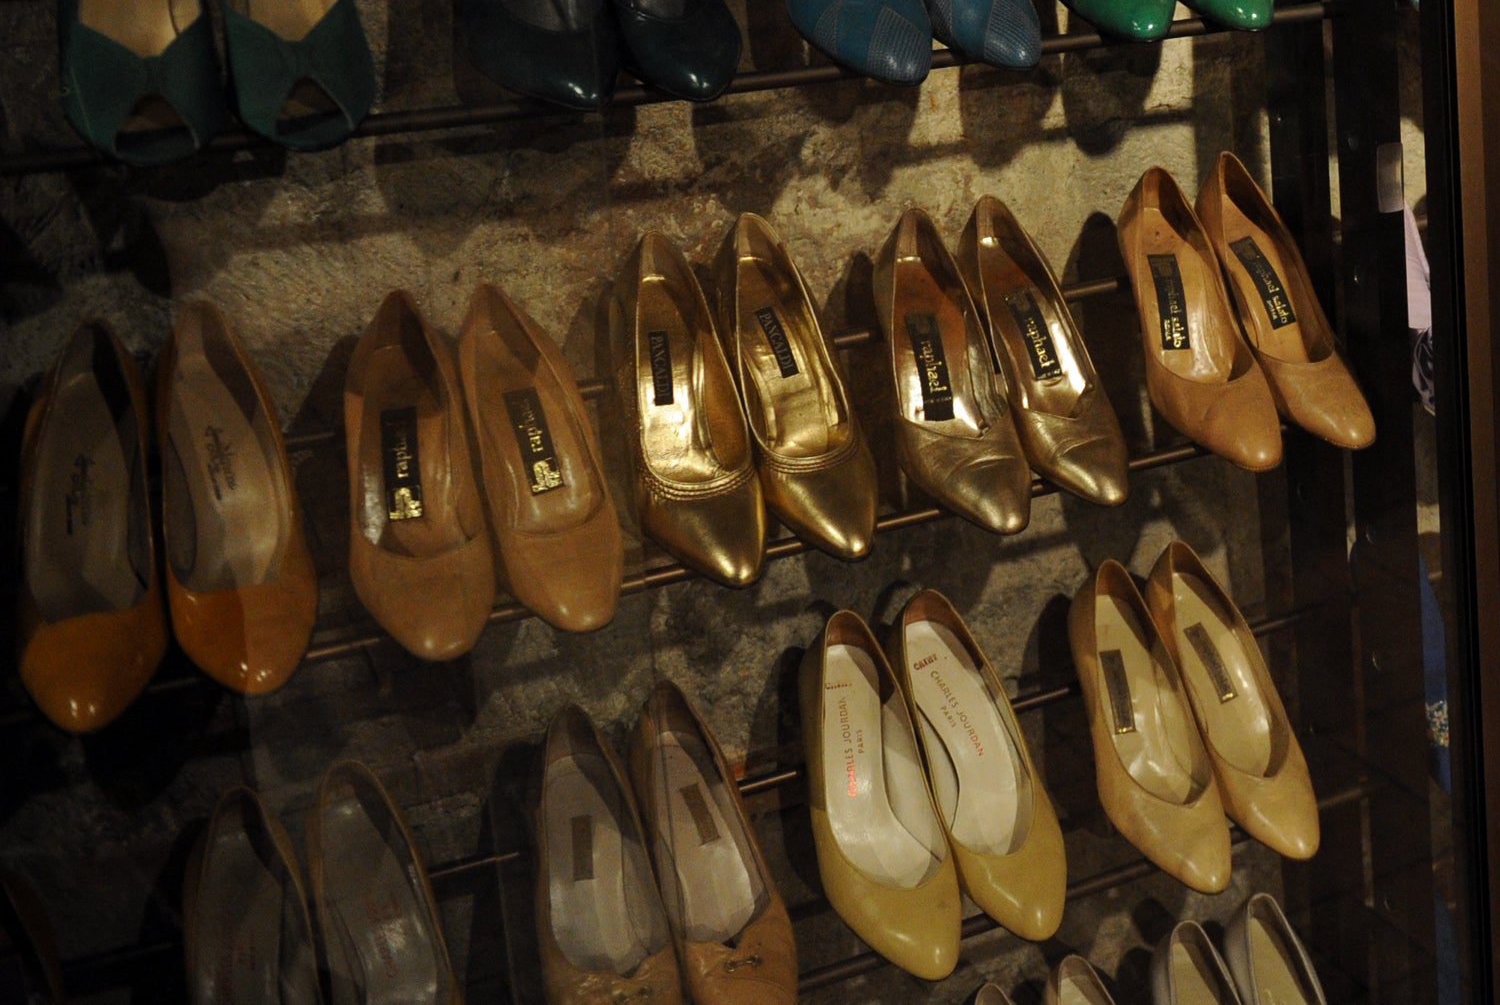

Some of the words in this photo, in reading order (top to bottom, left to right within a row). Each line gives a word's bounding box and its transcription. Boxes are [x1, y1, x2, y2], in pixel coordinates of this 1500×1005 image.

[651, 334, 671, 397] PANCALDI
[760, 313, 793, 374] PANCALDI
[919, 340, 949, 393] raphael
[838, 696, 853, 744] JOURDAN
[930, 670, 960, 710] CHARLES
[956, 709, 985, 757] JOURDAN
[940, 706, 958, 729] PARIS
[856, 728, 865, 755] PARIS
